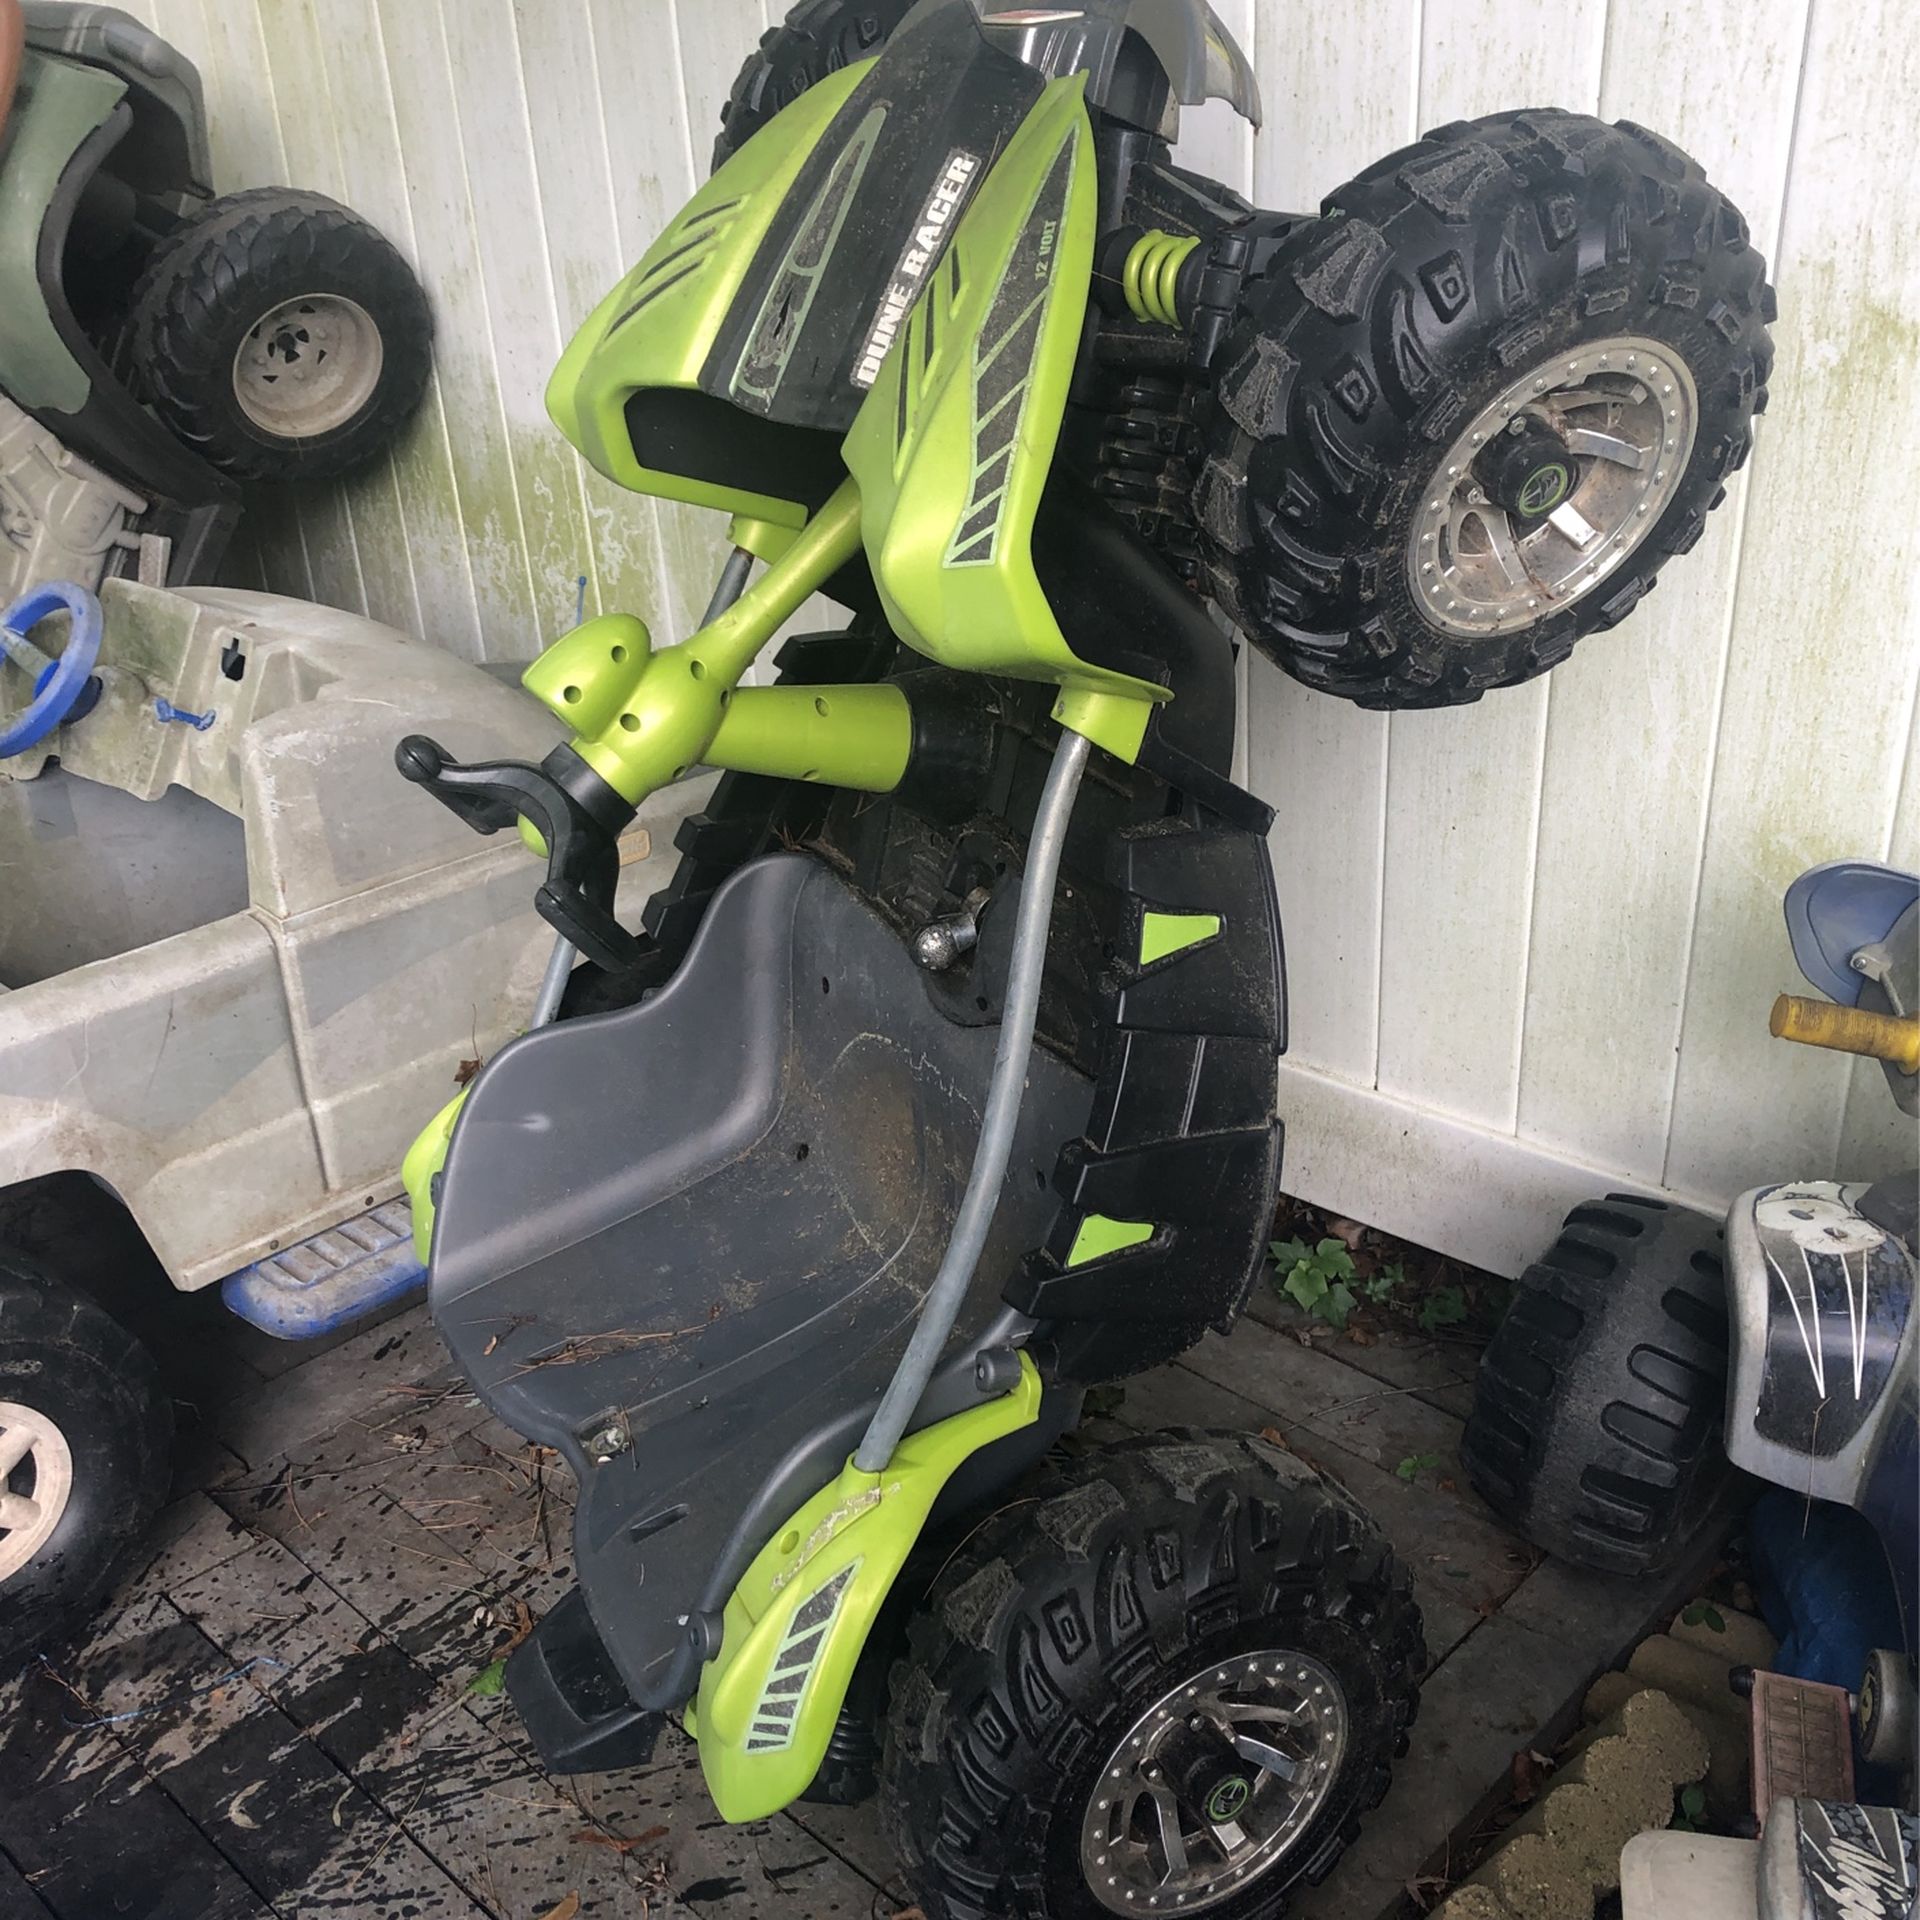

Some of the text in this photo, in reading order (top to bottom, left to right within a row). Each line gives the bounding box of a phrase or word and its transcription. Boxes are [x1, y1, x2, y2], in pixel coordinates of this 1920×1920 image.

[856, 156, 975, 384] DUNE RACER
[1035, 220, 1057, 281] 12 VOLT
